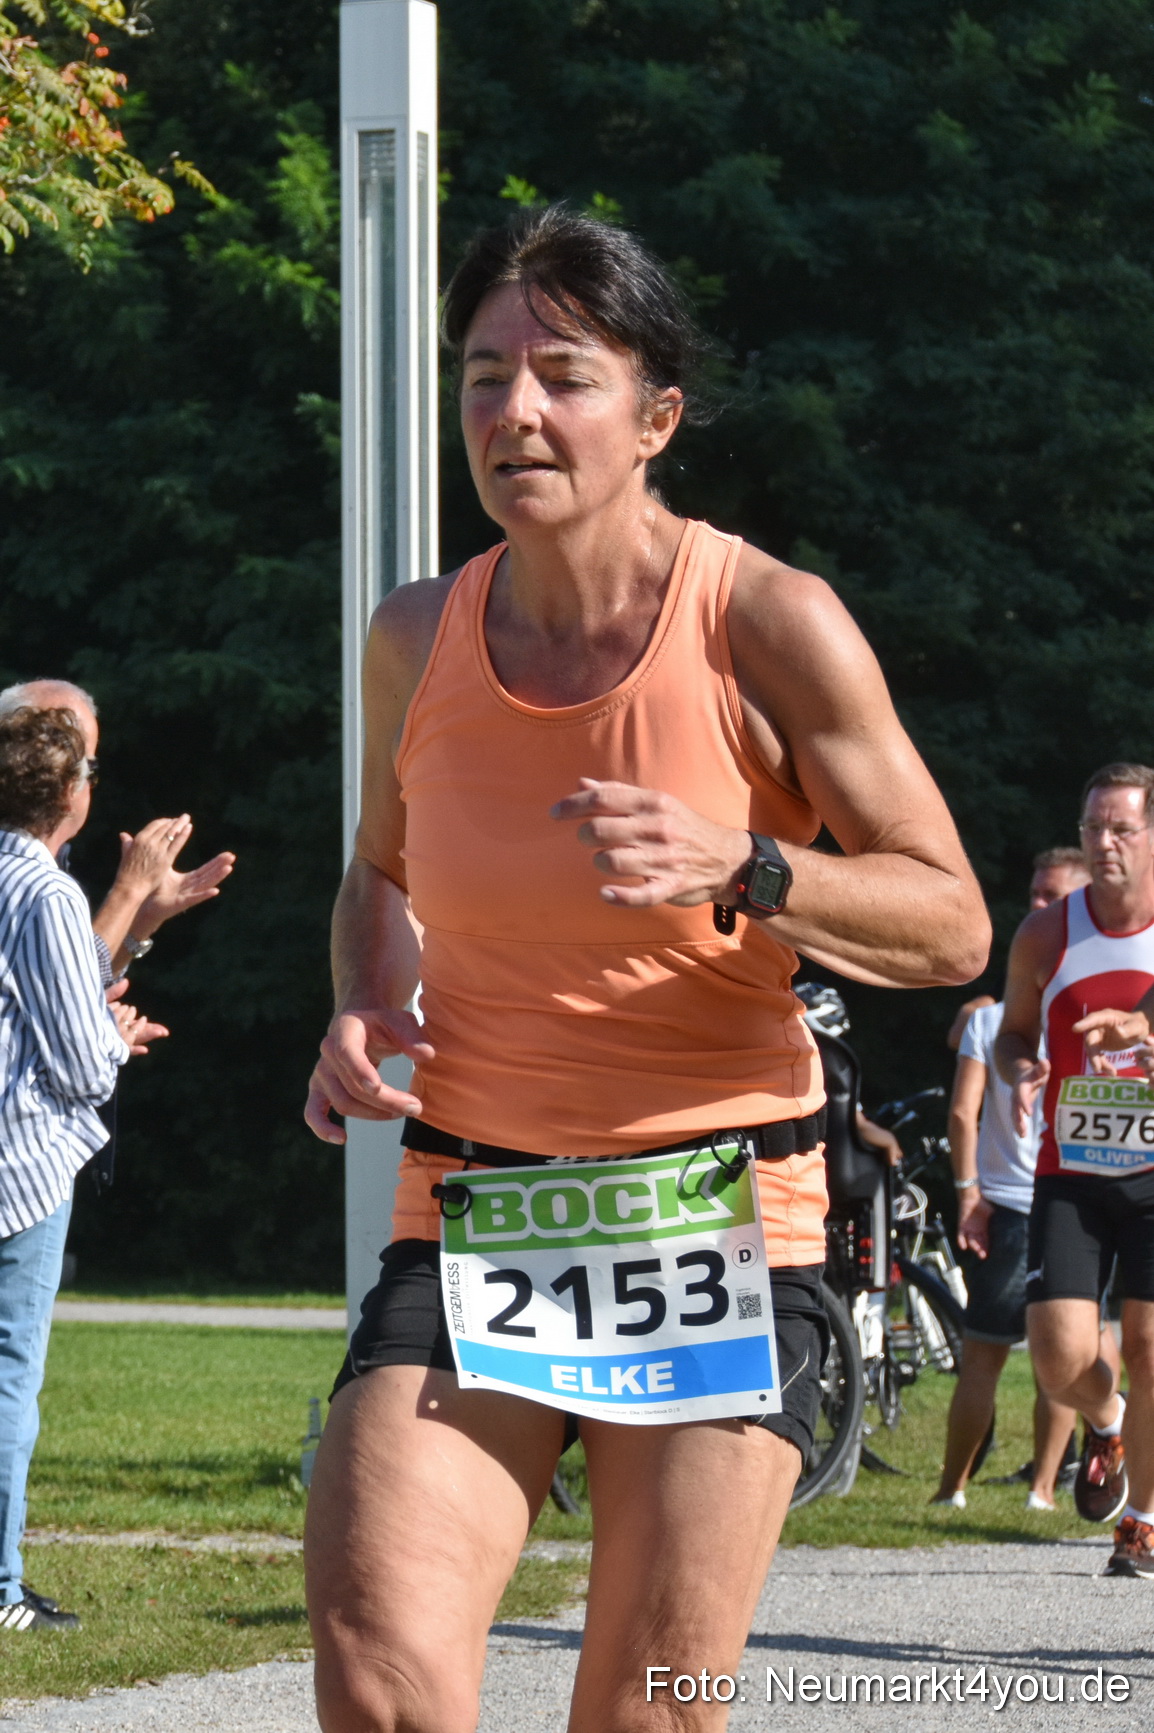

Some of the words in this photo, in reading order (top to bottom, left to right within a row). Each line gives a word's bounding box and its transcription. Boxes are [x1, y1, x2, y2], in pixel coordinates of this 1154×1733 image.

[1069, 1111, 1154, 1144] 2576
[467, 1164, 731, 1240] BOCK
[738, 1248, 752, 1264] D
[483, 1250, 729, 1340] 2153
[550, 1360, 675, 1395] ELKE
